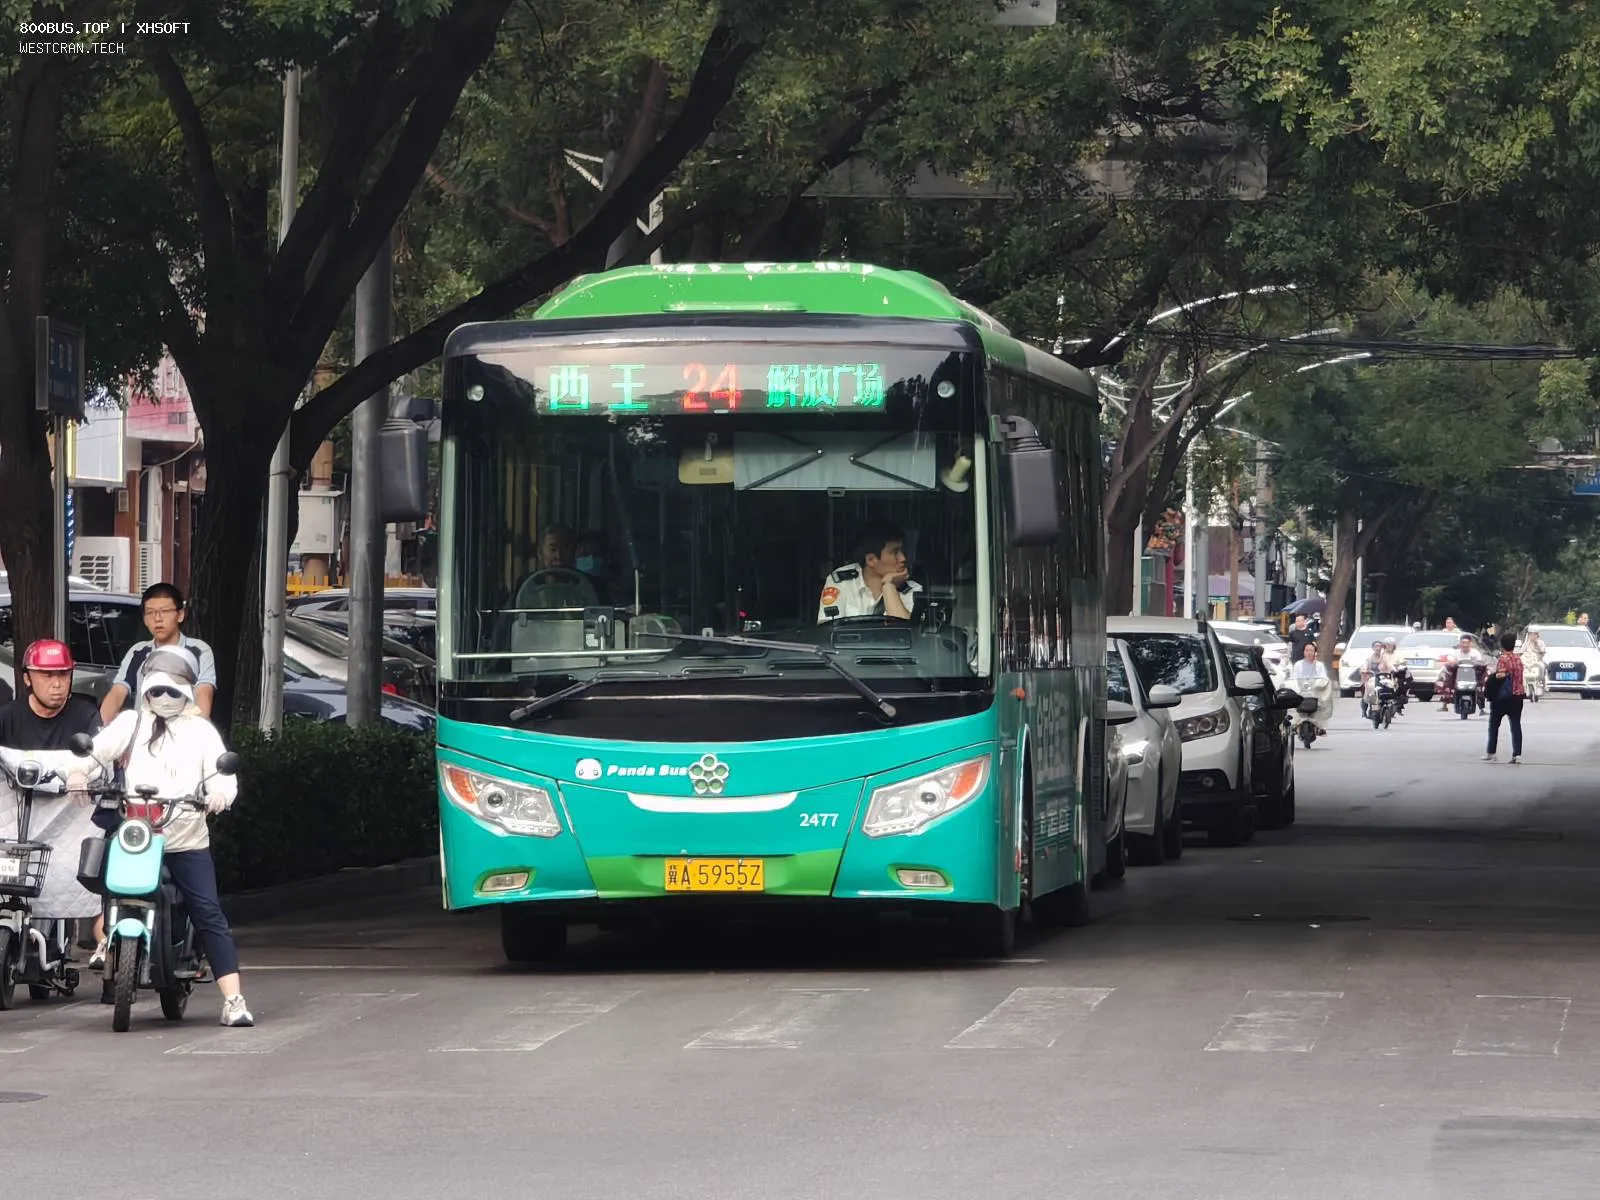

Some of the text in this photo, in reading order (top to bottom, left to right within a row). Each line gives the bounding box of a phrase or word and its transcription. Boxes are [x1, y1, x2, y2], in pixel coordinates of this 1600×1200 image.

[682, 362, 742, 409] 24
[766, 363, 884, 408] 解放广场
[606, 764, 689, 777] Panda Bus
[800, 812, 838, 828] 2477
